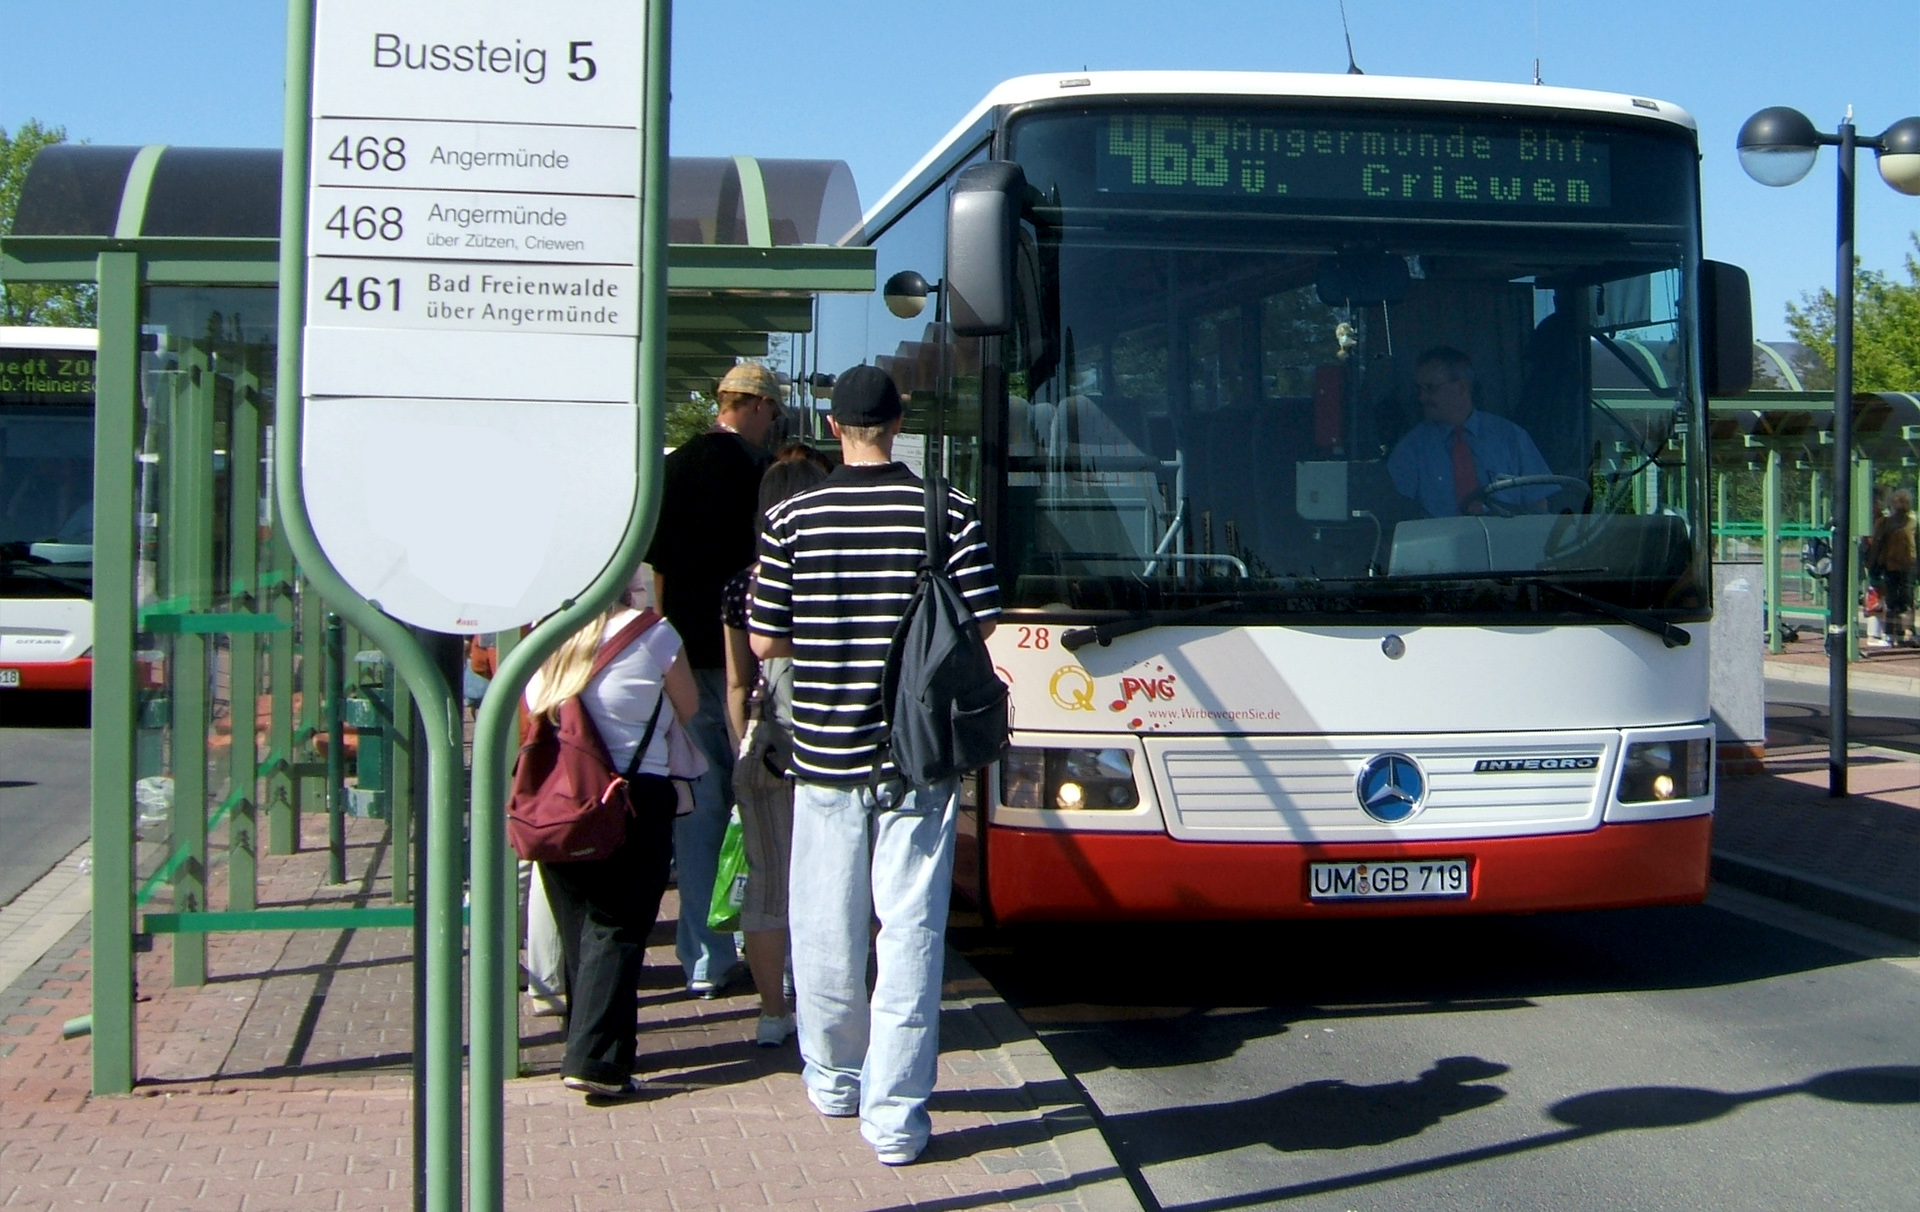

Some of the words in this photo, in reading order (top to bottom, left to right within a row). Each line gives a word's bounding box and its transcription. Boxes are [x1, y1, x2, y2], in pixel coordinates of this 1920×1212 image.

[373, 32, 548, 85] Bussteig
[567, 40, 598, 82] 5
[1109, 115, 1230, 187] 468
[1232, 118, 1491, 160] Angermünde
[1520, 128, 1598, 163] Bhf.
[328, 135, 407, 172] 468
[430, 146, 570, 171] Angermünde
[1362, 163, 1590, 203] Criewen
[325, 204, 404, 241] 468
[427, 203, 568, 228] Angermünde
[426, 233, 460, 247] über
[465, 233, 519, 250] Zützen,
[524, 235, 585, 251] Criewen
[324, 276, 402, 312] 461
[428, 273, 471, 293] Bad
[481, 275, 620, 298] Freienwalde
[427, 301, 475, 320] über
[481, 303, 620, 326] Angermünde
[1017, 626, 1050, 650] 28
[1121, 677, 1176, 701] PVG
[1148, 707, 1281, 721] www.WirbewegenSie.de
[1479, 758, 1595, 771] INTEGRO
[1314, 867, 1356, 894] UM
[1372, 866, 1409, 893] GB
[1419, 864, 1462, 891] 719
